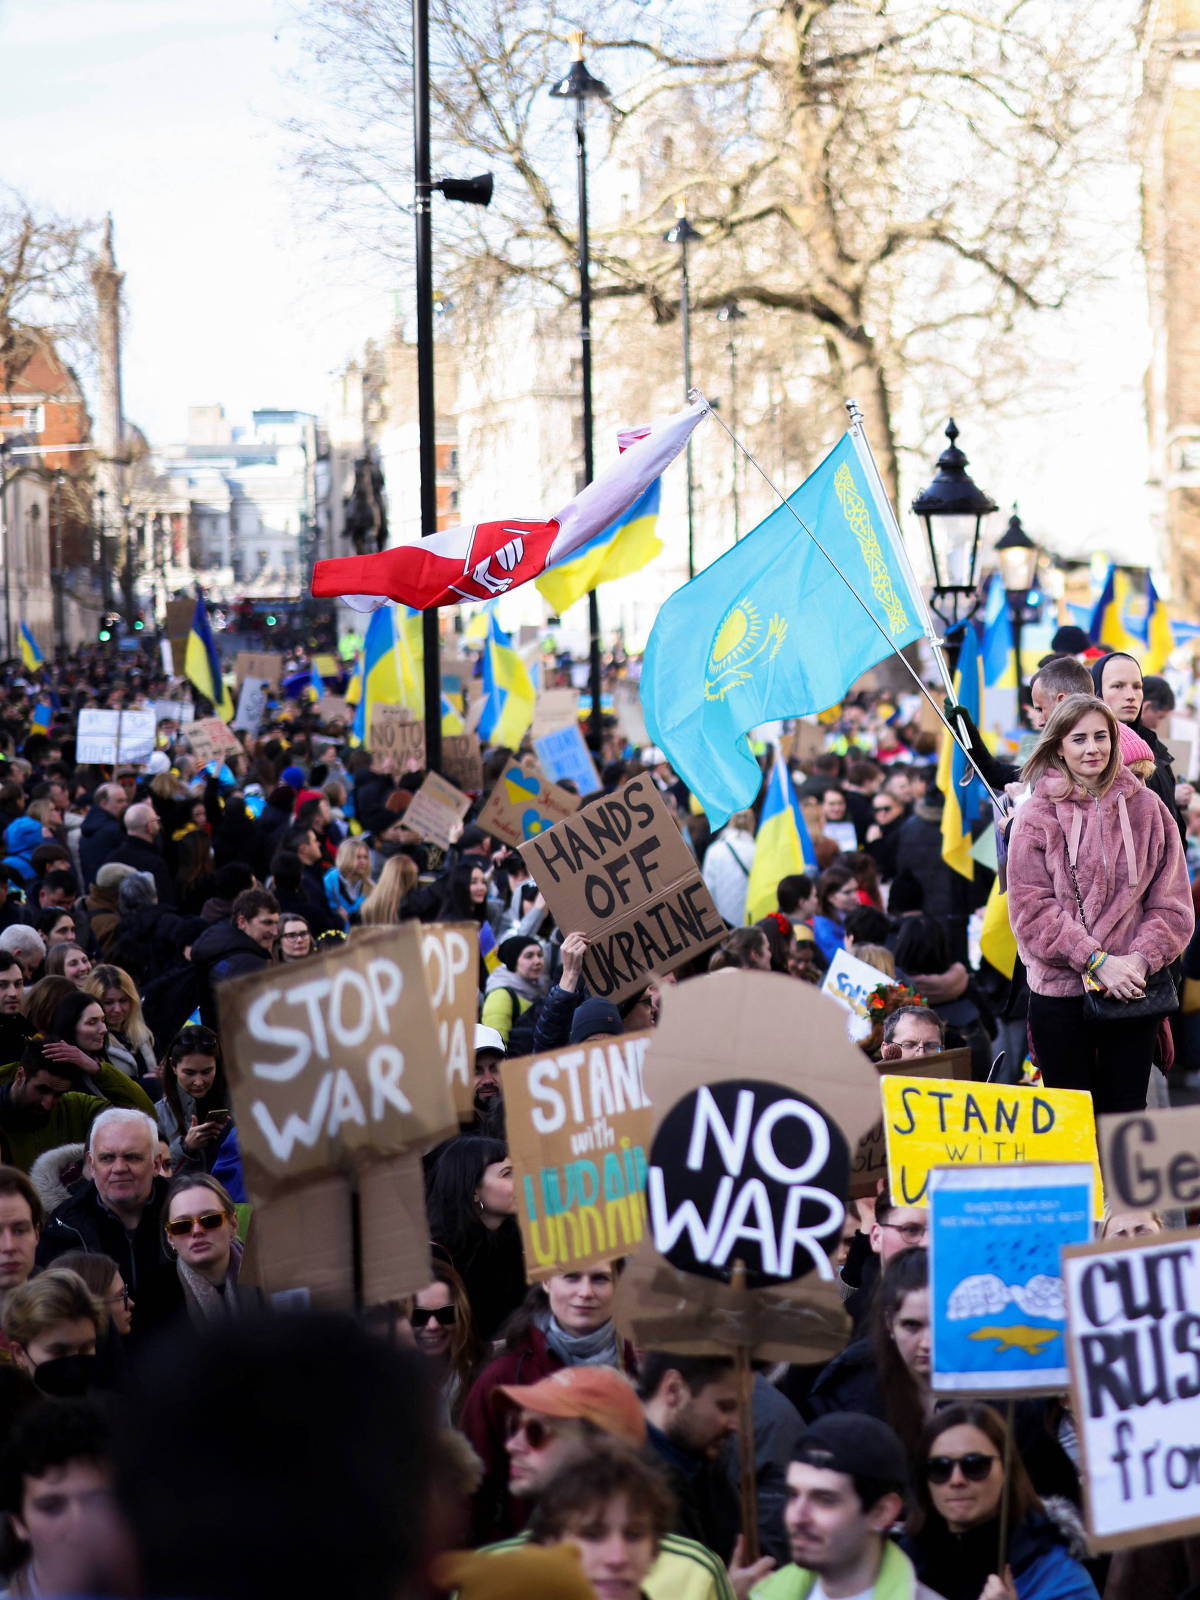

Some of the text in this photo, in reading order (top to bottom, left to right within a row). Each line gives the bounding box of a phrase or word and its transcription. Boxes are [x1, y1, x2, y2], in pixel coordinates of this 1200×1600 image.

[534, 782, 655, 882] HANDS
[585, 835, 661, 918] OFF
[582, 882, 723, 997] UKRAINE
[247, 957, 403, 1082] STOP
[251, 1044, 413, 1162] WAR
[570, 1115, 615, 1156] with
[687, 1085, 830, 1185] NO
[893, 1088, 1055, 1135] STAND
[649, 1166, 845, 1280] WAR
[1080, 1244, 1193, 1328] CUT
